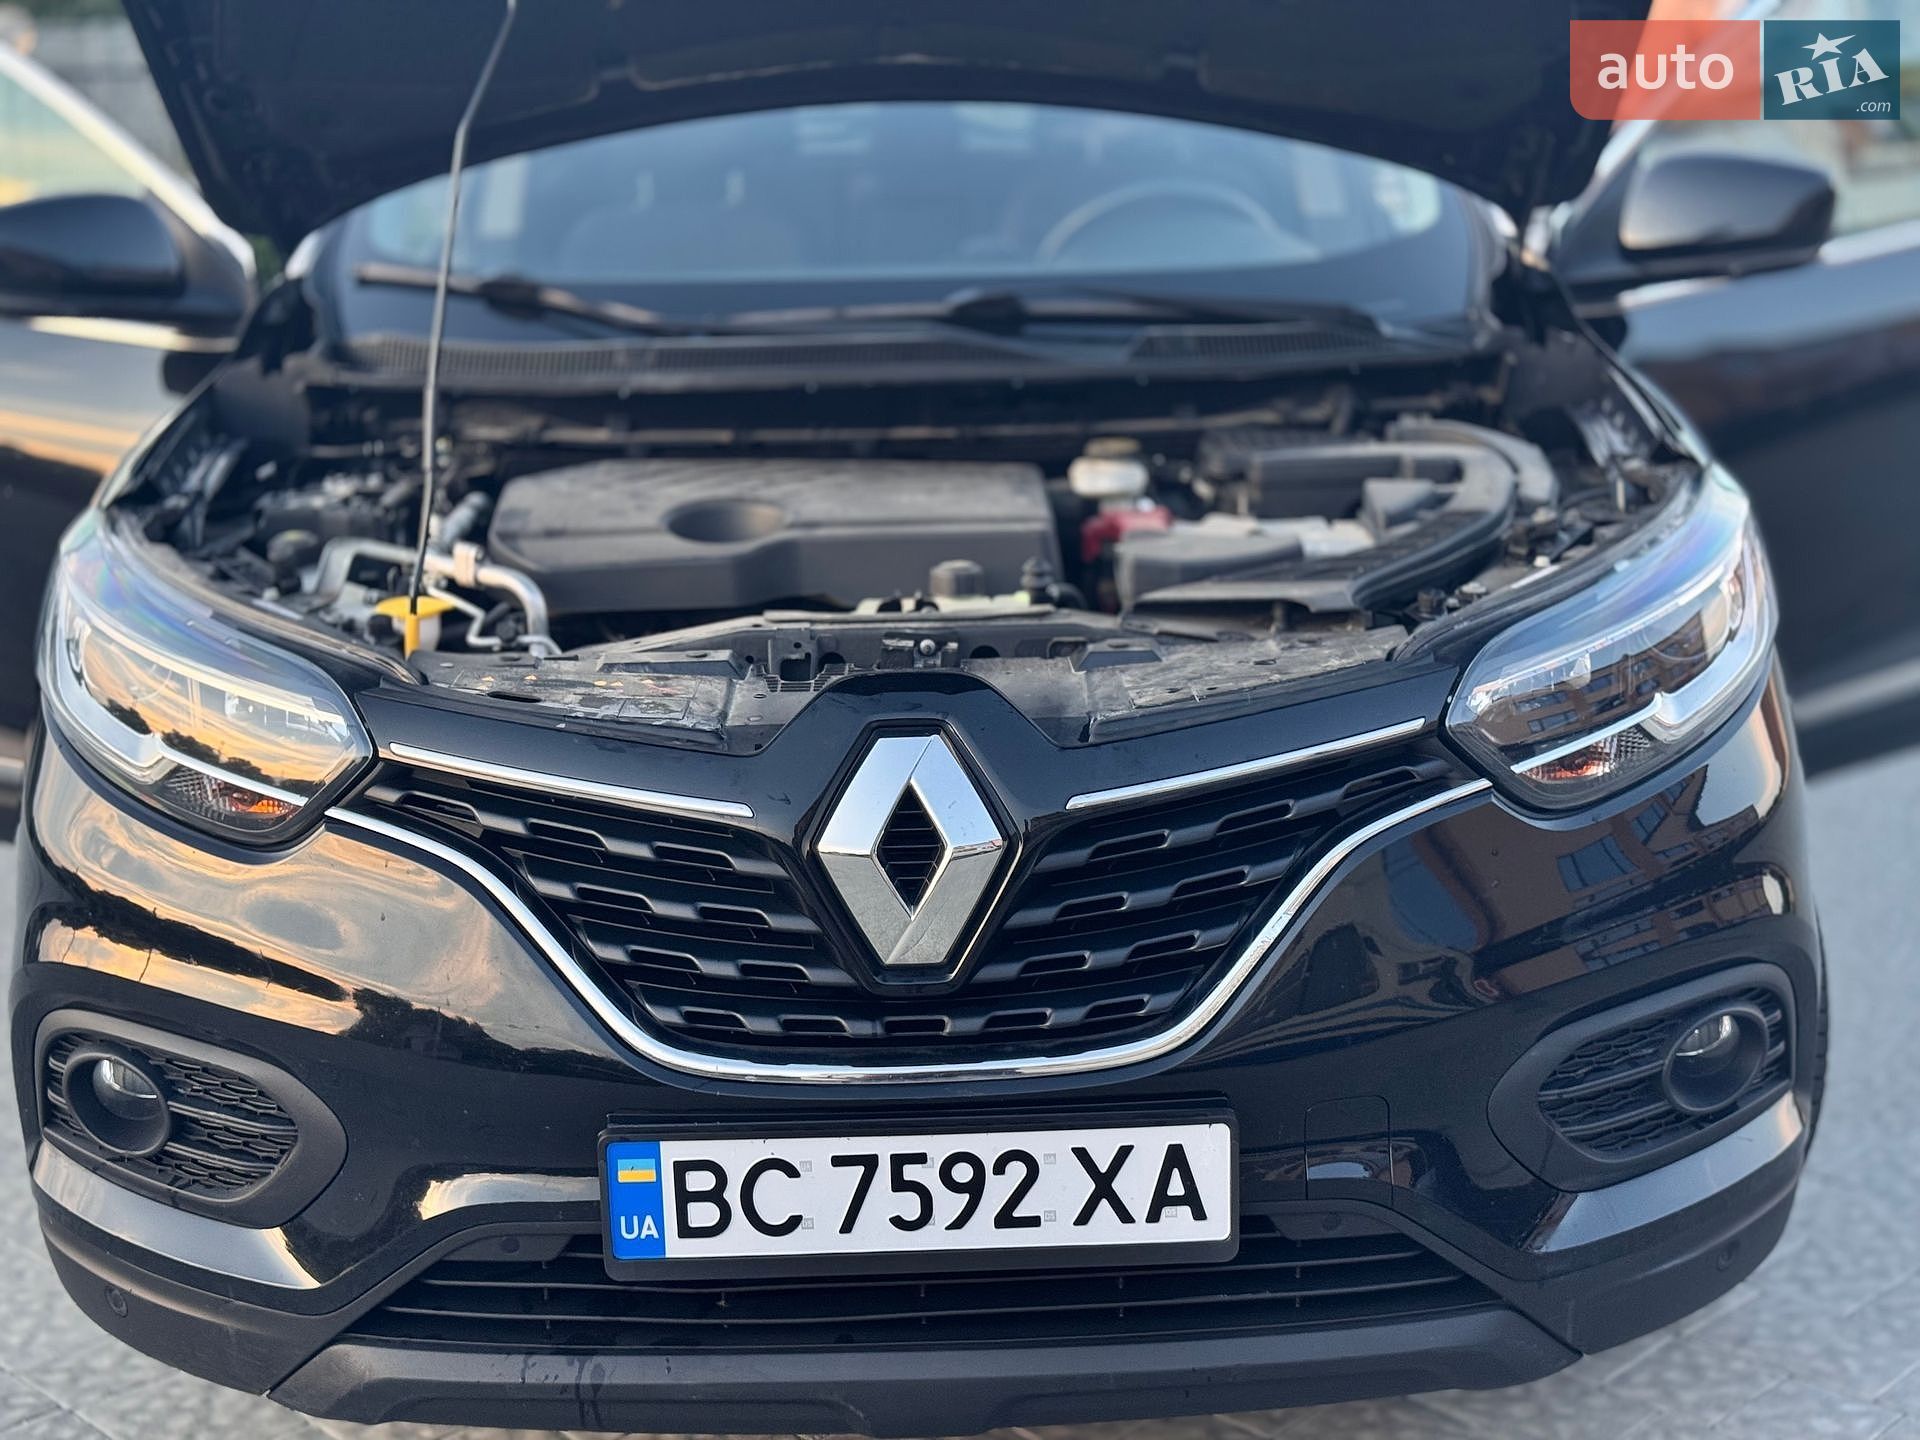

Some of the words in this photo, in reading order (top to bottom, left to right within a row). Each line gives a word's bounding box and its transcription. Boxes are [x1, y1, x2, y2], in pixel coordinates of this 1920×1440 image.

[673, 1157, 803, 1239] BC
[830, 1148, 1042, 1235] 7592
[1070, 1143, 1208, 1227] XA
[620, 1214, 660, 1240] UA
